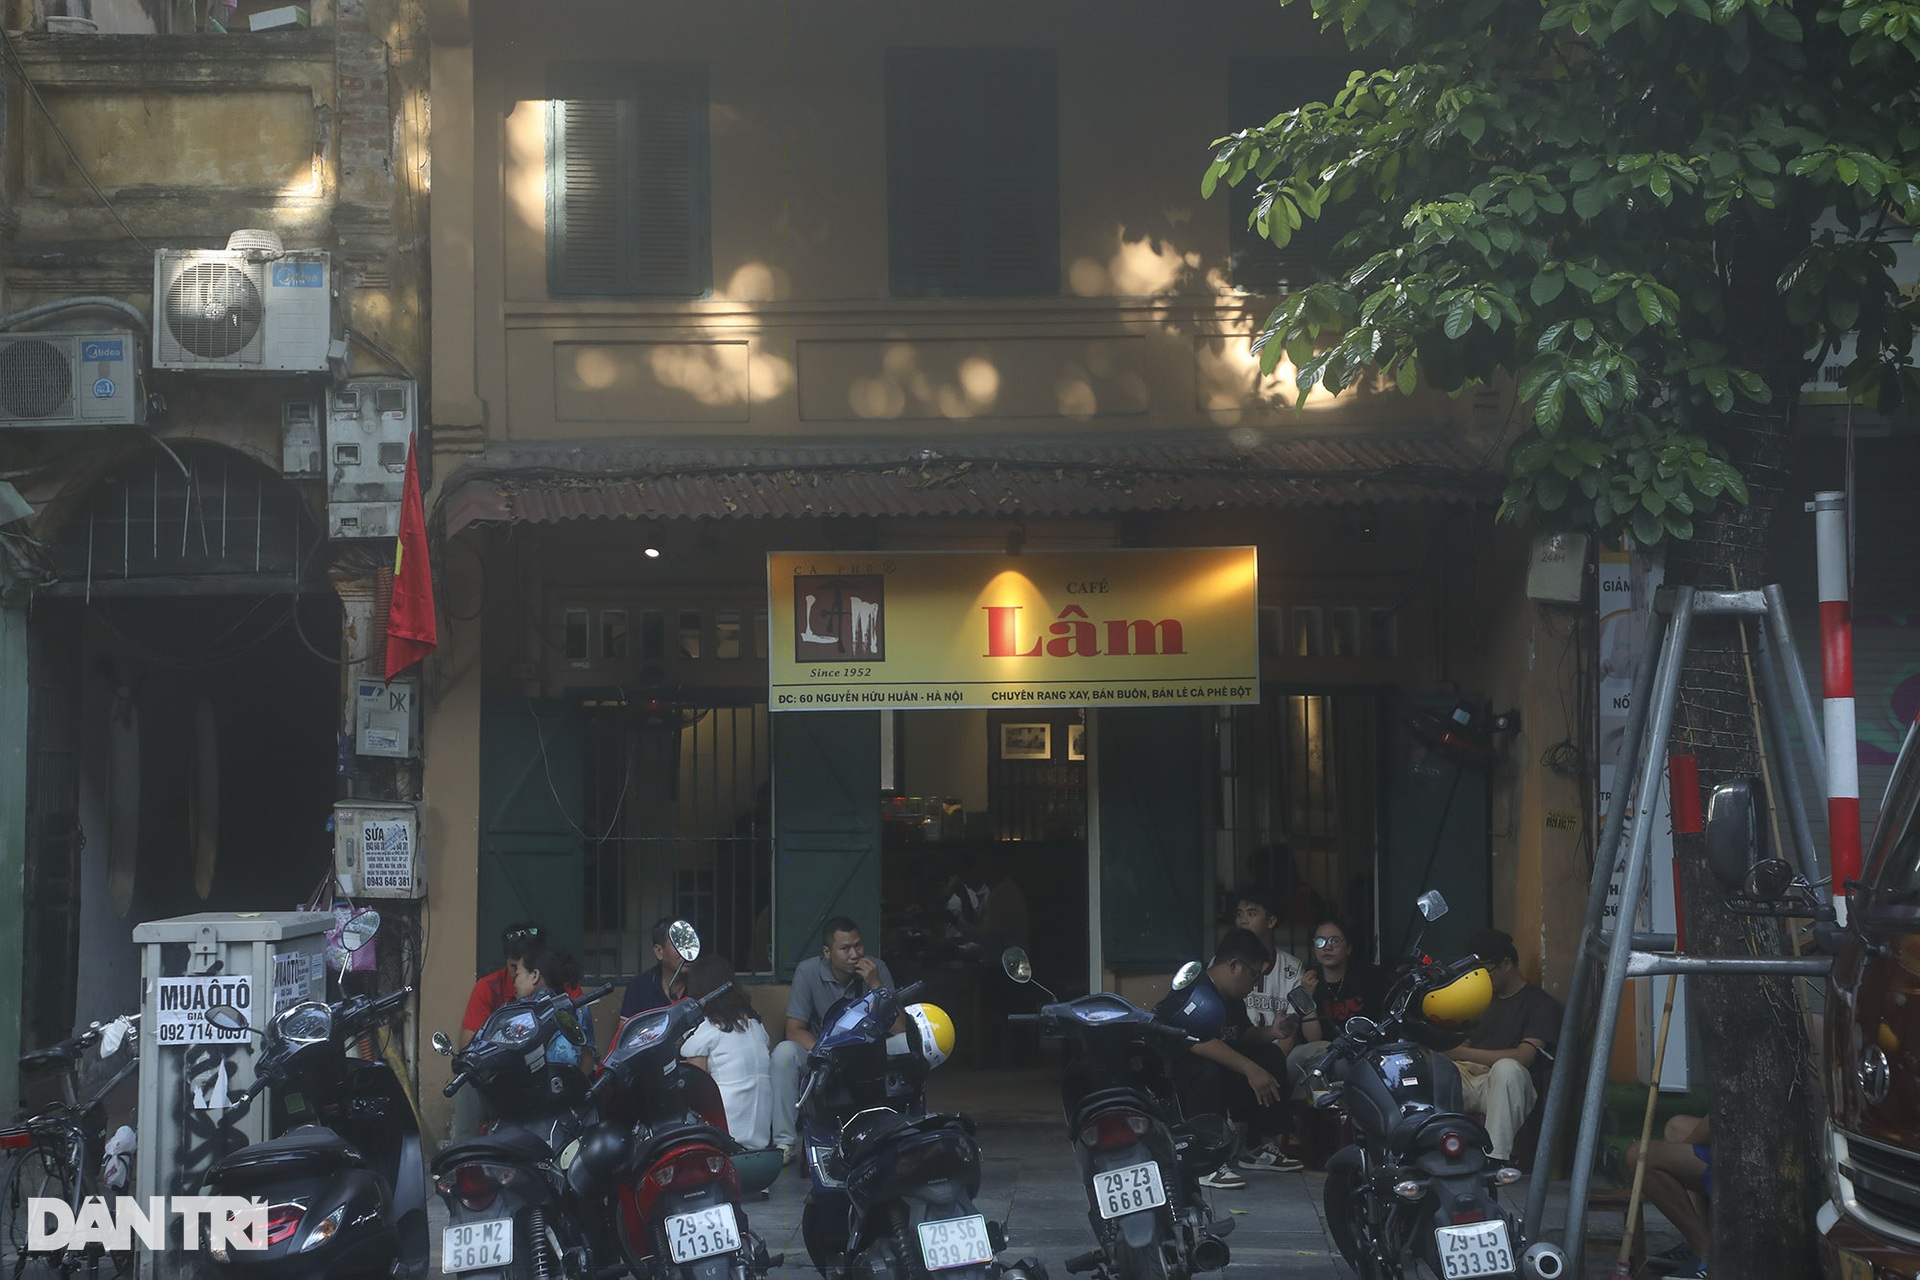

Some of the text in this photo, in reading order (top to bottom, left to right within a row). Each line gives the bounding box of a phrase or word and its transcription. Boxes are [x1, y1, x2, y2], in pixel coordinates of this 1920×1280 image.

[86, 344, 120, 358] Midea
[1066, 578, 1109, 594] CAFÉ
[981, 604, 1188, 658] Lâm
[810, 668, 872, 678] Since 1952
[778, 694, 797, 704] ĐC:
[799, 694, 813, 703] 60
[926, 690, 942, 702] HÀ
[944, 690, 963, 704] NỘI
[991, 689, 1033, 701] CHUYÊN
[1037, 690, 1066, 701] RANG
[1068, 690, 1090, 702] XAY,
[1092, 686, 1115, 700] BÁN
[1117, 687, 1150, 701] BUÔN,
[1152, 686, 1174, 699] BÁN
[1207, 685, 1228, 698] PHÊ
[1230, 685, 1252, 699] BỘT
[365, 822, 384, 841] SỬA
[366, 876, 410, 887] 0943 646 381
[160, 1024, 185, 1041] 092
[188, 1023, 213, 1040] 714
[1104, 1167, 1151, 1194] 29-Z3
[684, 1190, 706, 1198] HONDA
[1108, 1185, 1155, 1214] 6681
[676, 1208, 724, 1238] 29-S1
[929, 1220, 977, 1246] 29-S6
[677, 1228, 736, 1259] 413.64
[928, 1240, 988, 1267] 939.28
[453, 1243, 502, 1268] 5604
[1445, 1249, 1510, 1277] 533.93
